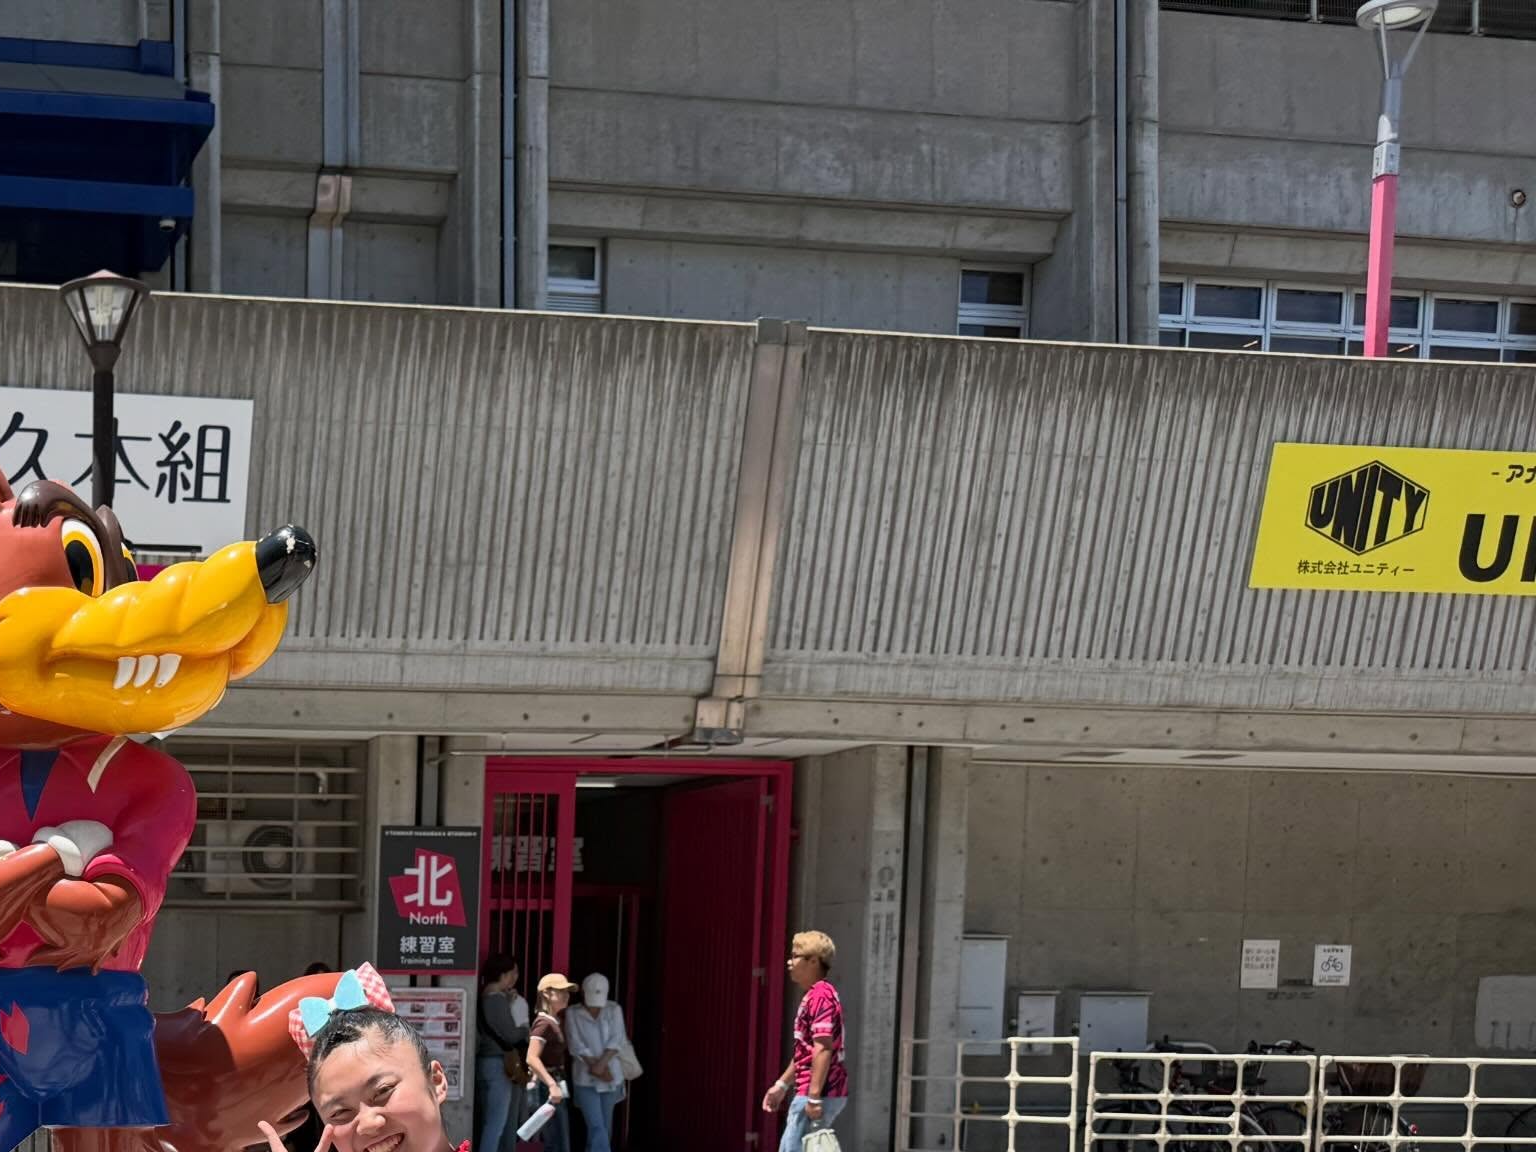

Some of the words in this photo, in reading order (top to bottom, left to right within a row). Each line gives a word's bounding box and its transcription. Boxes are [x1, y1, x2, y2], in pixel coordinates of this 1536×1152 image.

[1309, 463, 1428, 553] UNITY
[1458, 513, 1536, 583] U
[1297, 560, 1415, 576] 株式会社ユニティー
[404, 855, 453, 907] 北
[409, 911, 448, 925] North
[400, 936, 455, 954] 練習室
